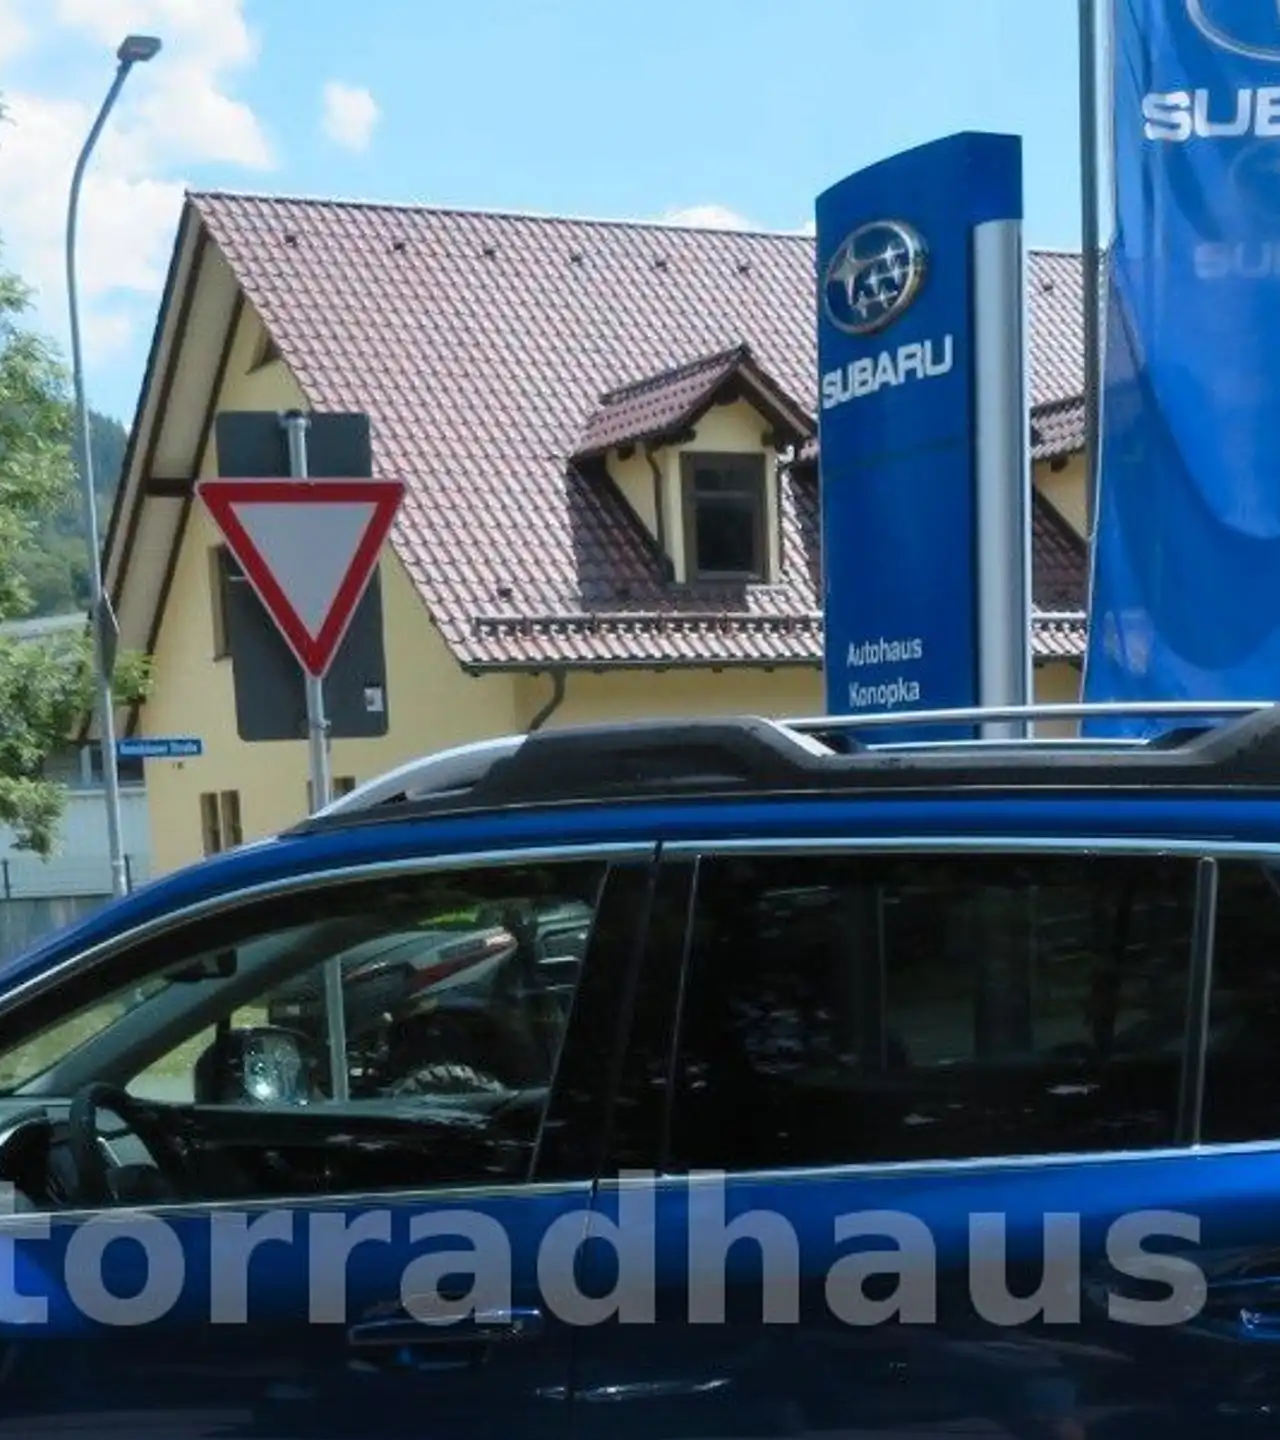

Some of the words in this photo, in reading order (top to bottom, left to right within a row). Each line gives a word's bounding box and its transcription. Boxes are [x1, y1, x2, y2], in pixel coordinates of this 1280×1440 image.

[822, 334, 953, 409] SUBARU
[846, 636, 922, 668] Autohaus
[848, 677, 920, 709] Konopka
